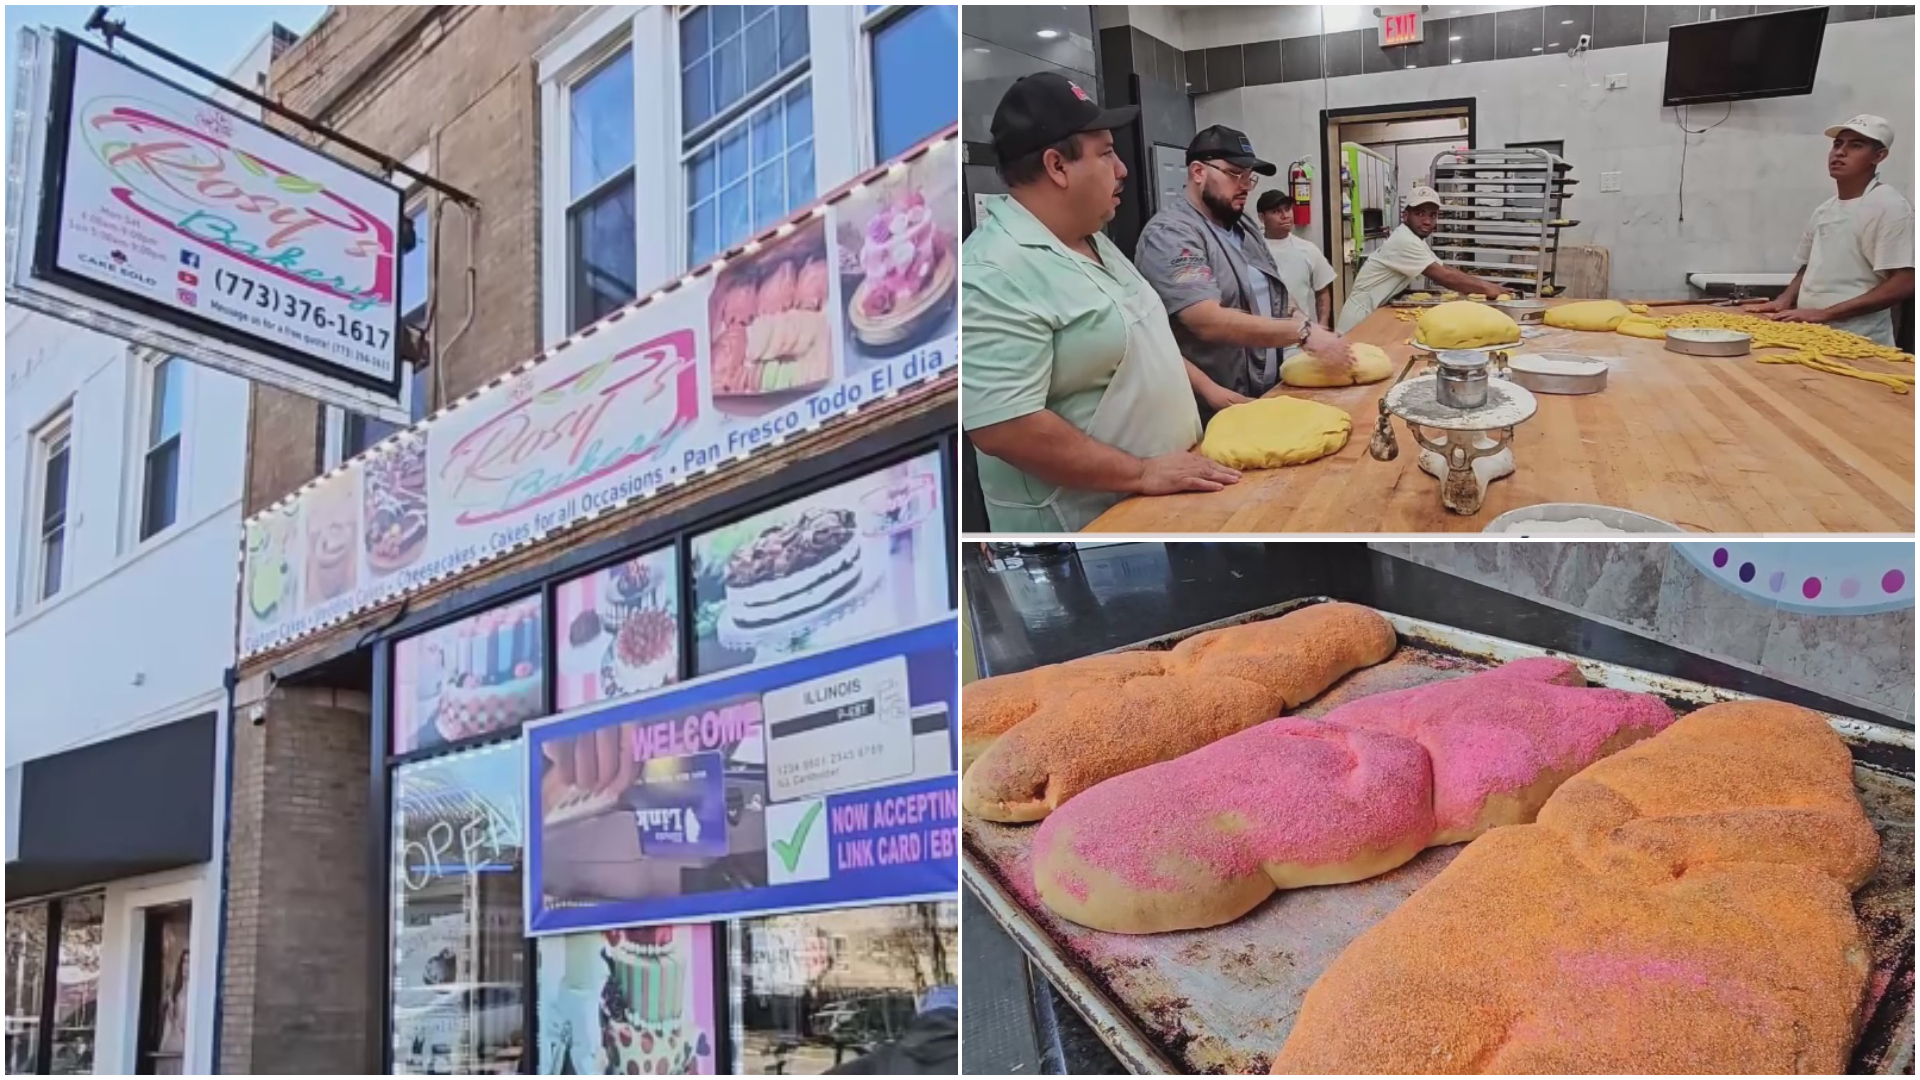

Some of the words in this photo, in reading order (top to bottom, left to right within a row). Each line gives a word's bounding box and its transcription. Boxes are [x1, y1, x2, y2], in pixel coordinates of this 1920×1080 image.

[1385, 13, 1416, 43] EXIT
[177, 209, 382, 310] Bakery
[397, 543, 478, 589] Cheesecakes
[489, 519, 531, 551] Cakes
[533, 509, 558, 530] for
[557, 495, 577, 517] all
[580, 467, 664, 513] Occasions
[683, 443, 721, 471] Pan
[727, 410, 799, 450] Fresco
[805, 384, 863, 420] Todo
[870, 364, 893, 394] El
[902, 349, 942, 380] dia
[803, 678, 862, 705] ILLINOIS
[631, 701, 763, 763] WELCOME
[635, 807, 684, 832] Link
[831, 803, 869, 836] NOW
[403, 796, 522, 890] OPEN
[837, 839, 876, 871] LINK
[878, 832, 921, 866] CARD
